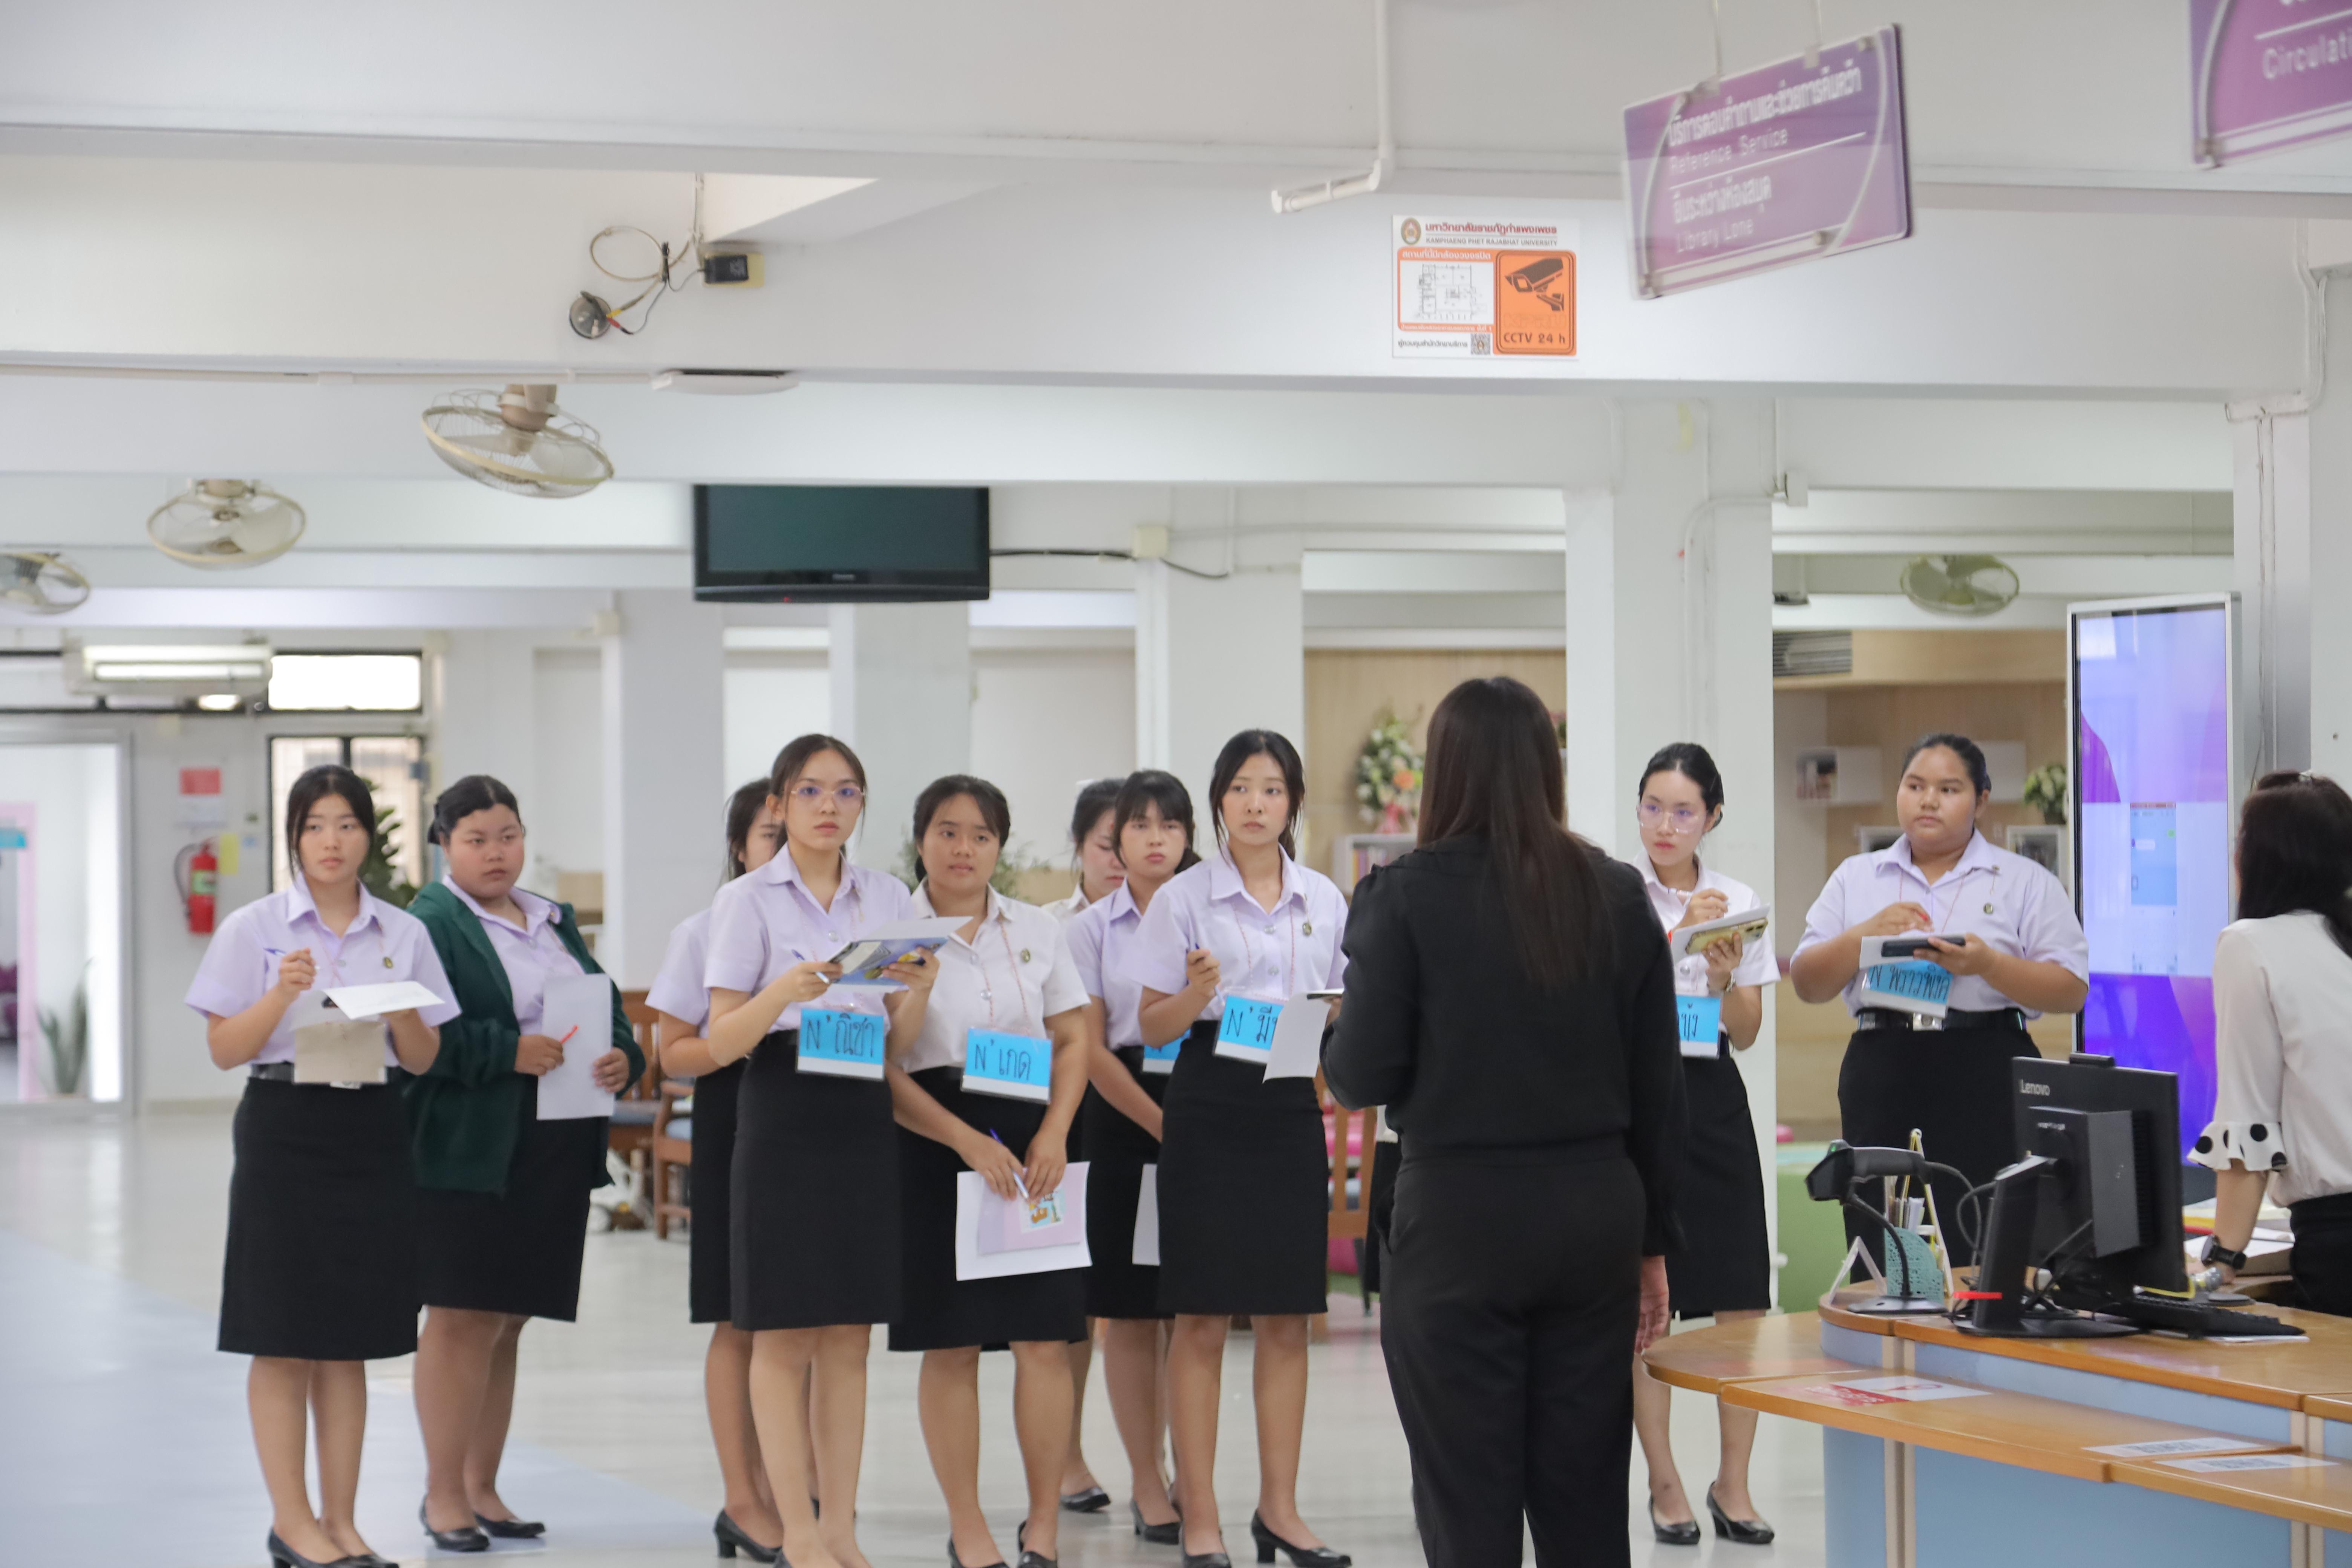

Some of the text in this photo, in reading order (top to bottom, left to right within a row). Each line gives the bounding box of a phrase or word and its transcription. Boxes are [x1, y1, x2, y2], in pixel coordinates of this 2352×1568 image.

[1670, 127, 1788, 175] Reference Service
[1676, 227, 1719, 253] Library
[1504, 332, 1565, 343] CCTV 24 h
[999, 1048, 1032, 1081] เกด
[2020, 1079, 2050, 1096] Lenovo
